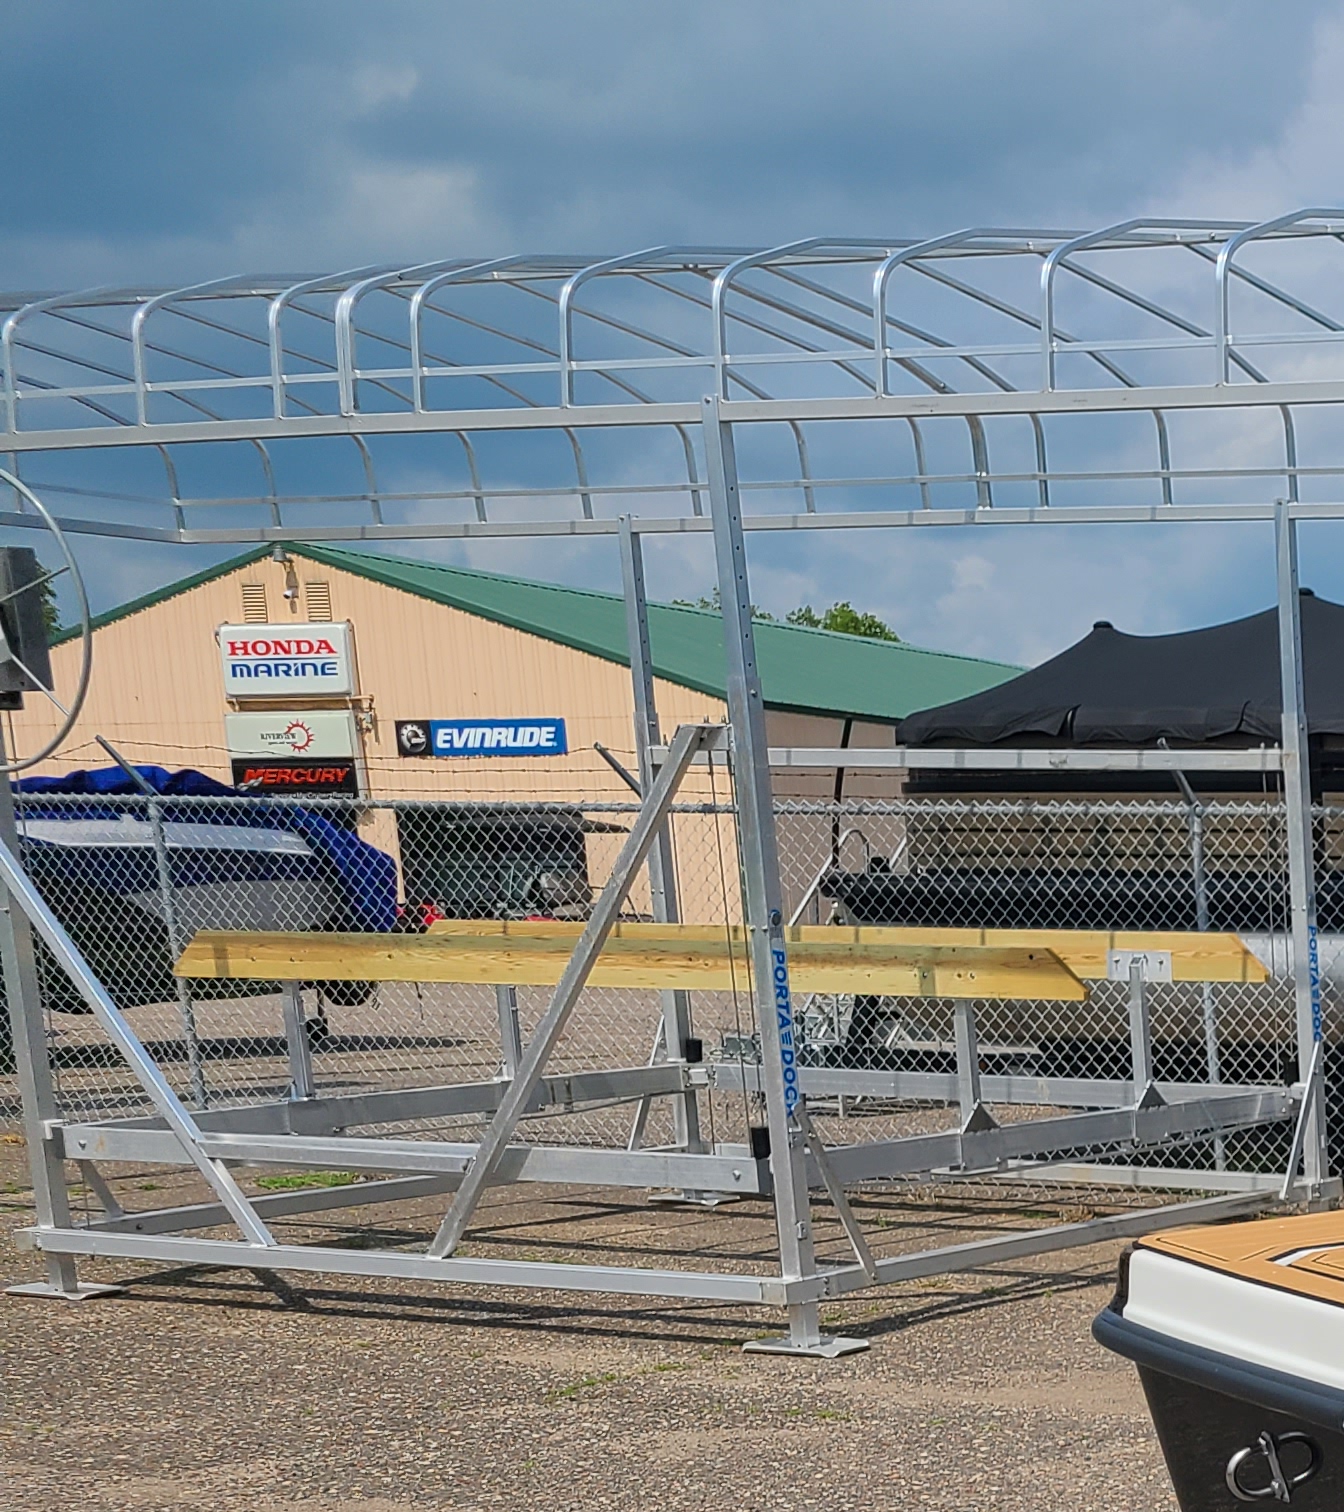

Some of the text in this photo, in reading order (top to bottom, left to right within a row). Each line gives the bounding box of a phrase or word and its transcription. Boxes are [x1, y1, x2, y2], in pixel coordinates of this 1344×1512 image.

[228, 640, 338, 656] HONDA
[436, 726, 556, 748] EVINRUDE
[244, 768, 350, 784] MERCURY
[772, 950, 792, 1028] PORTA
[1308, 925, 1322, 1042] PORTA DOC
